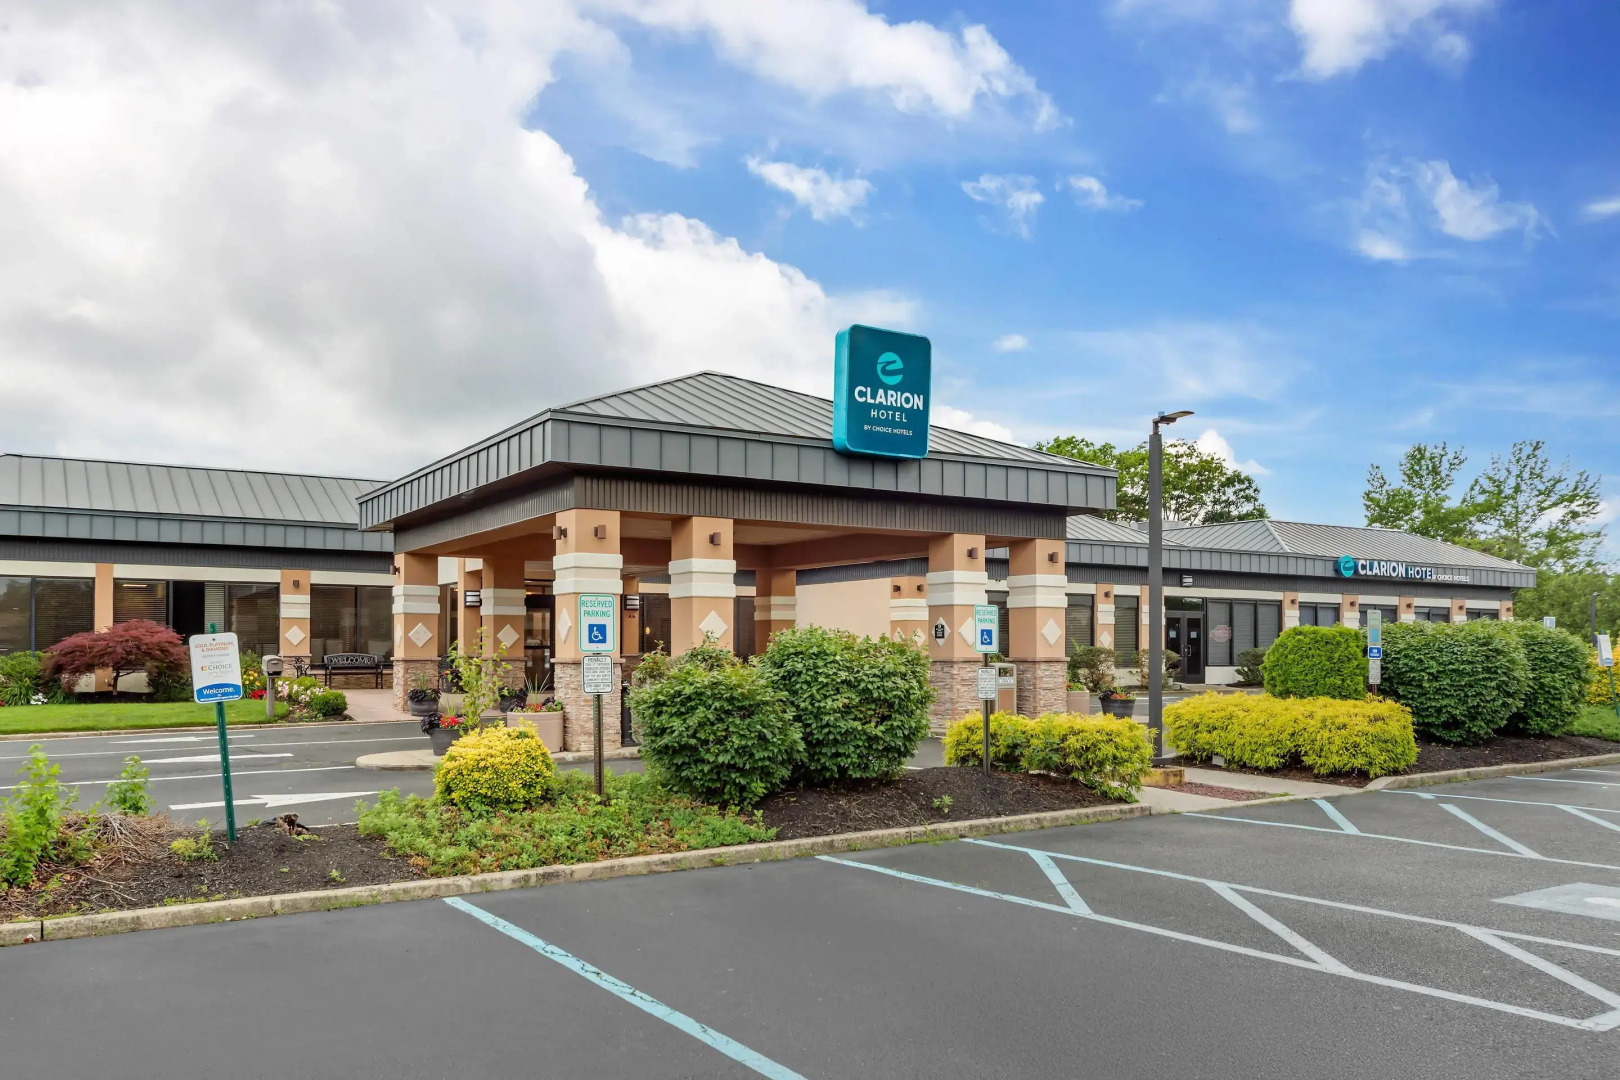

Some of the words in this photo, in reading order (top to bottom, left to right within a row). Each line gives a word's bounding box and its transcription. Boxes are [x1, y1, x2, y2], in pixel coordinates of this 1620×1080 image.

[854, 386, 924, 410] CLARION
[870, 409, 907, 422] HOTEL
[1358, 560, 1406, 578] CLARION
[1408, 566, 1434, 580] HOTEL
[582, 600, 612, 608] RESERVED
[583, 609, 610, 618] PARKING
[332, 656, 372, 664] WELCOME
[202, 687, 236, 695] Welcome.
